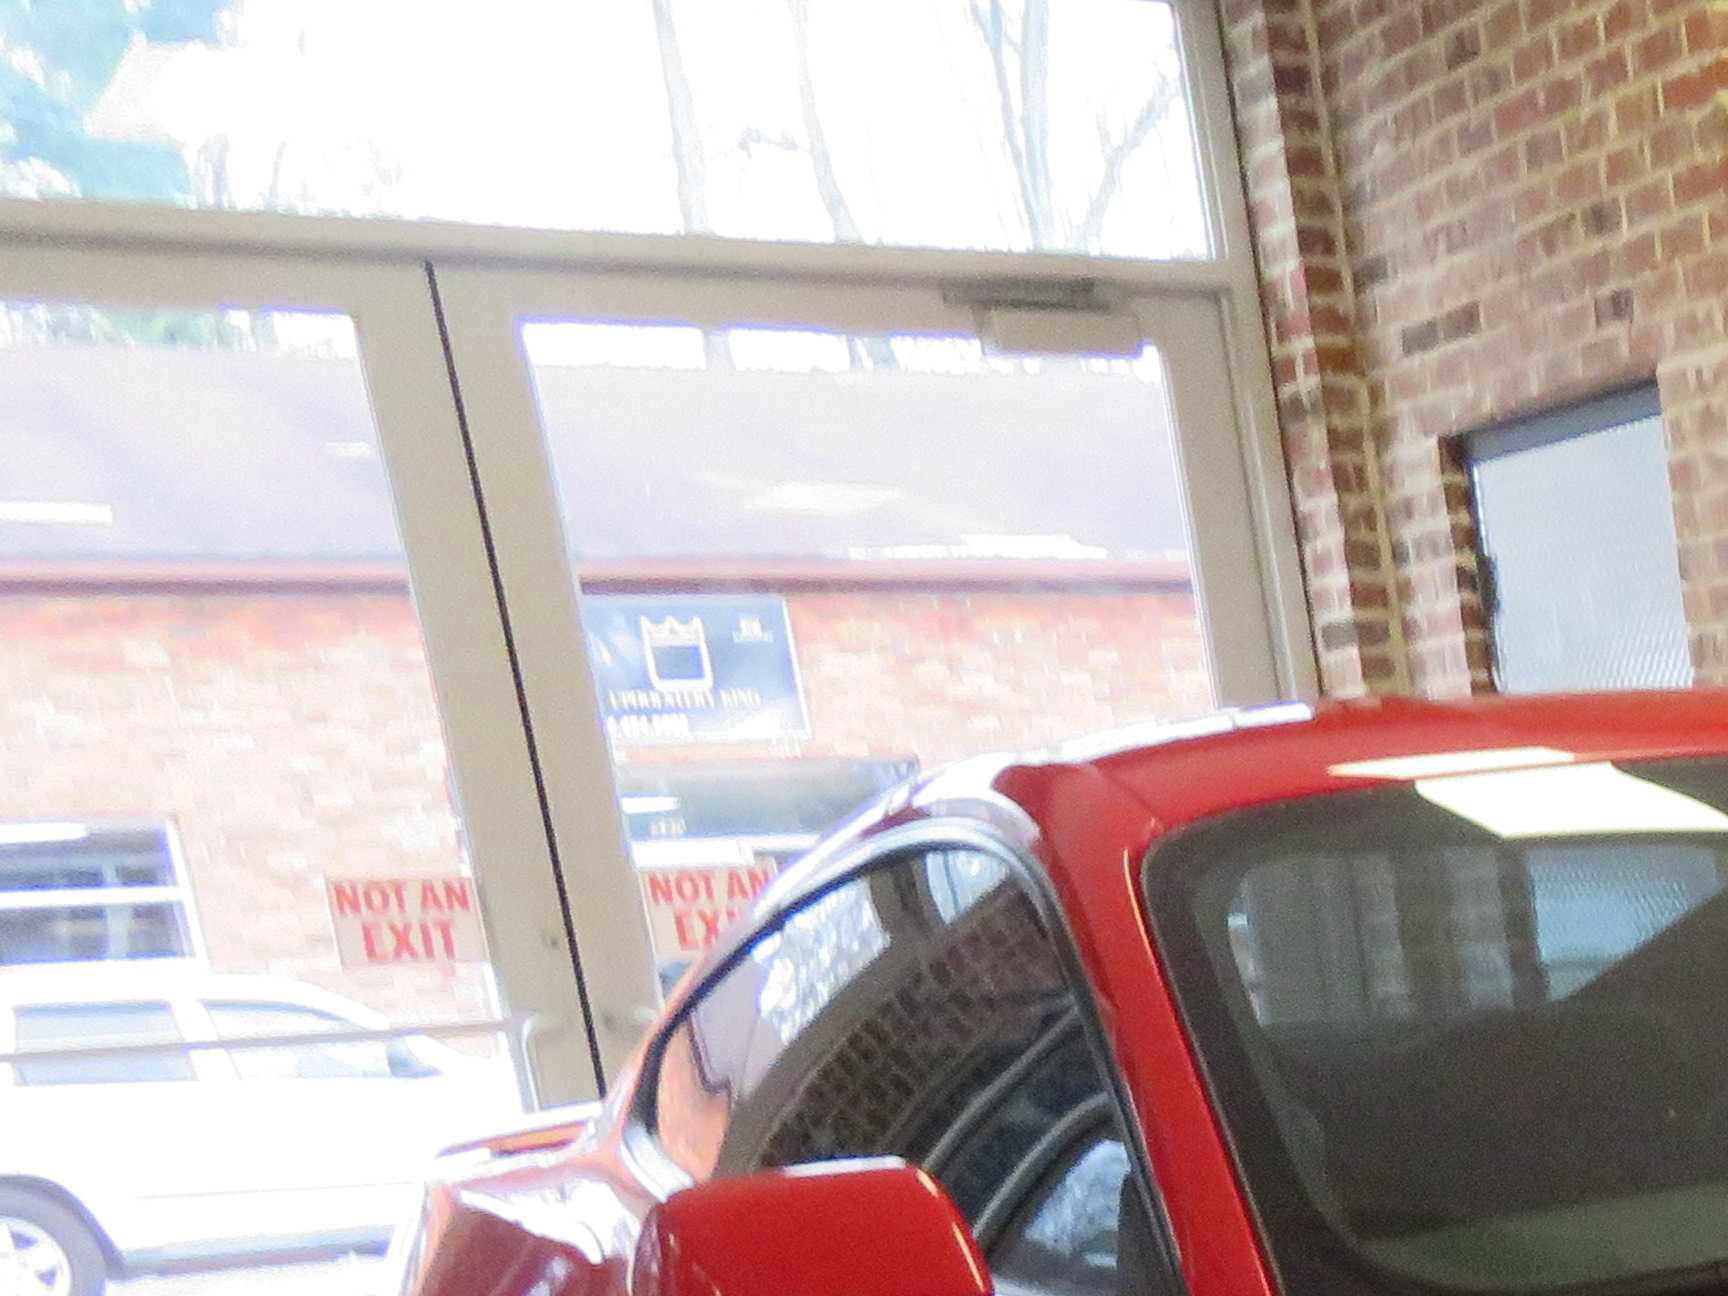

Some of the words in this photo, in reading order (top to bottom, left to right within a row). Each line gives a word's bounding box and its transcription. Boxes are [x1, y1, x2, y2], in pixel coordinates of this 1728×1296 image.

[334, 879, 405, 915] NOT
[421, 879, 472, 913] AN
[647, 869, 714, 905] NOT
[361, 918, 457, 962] EXIT
